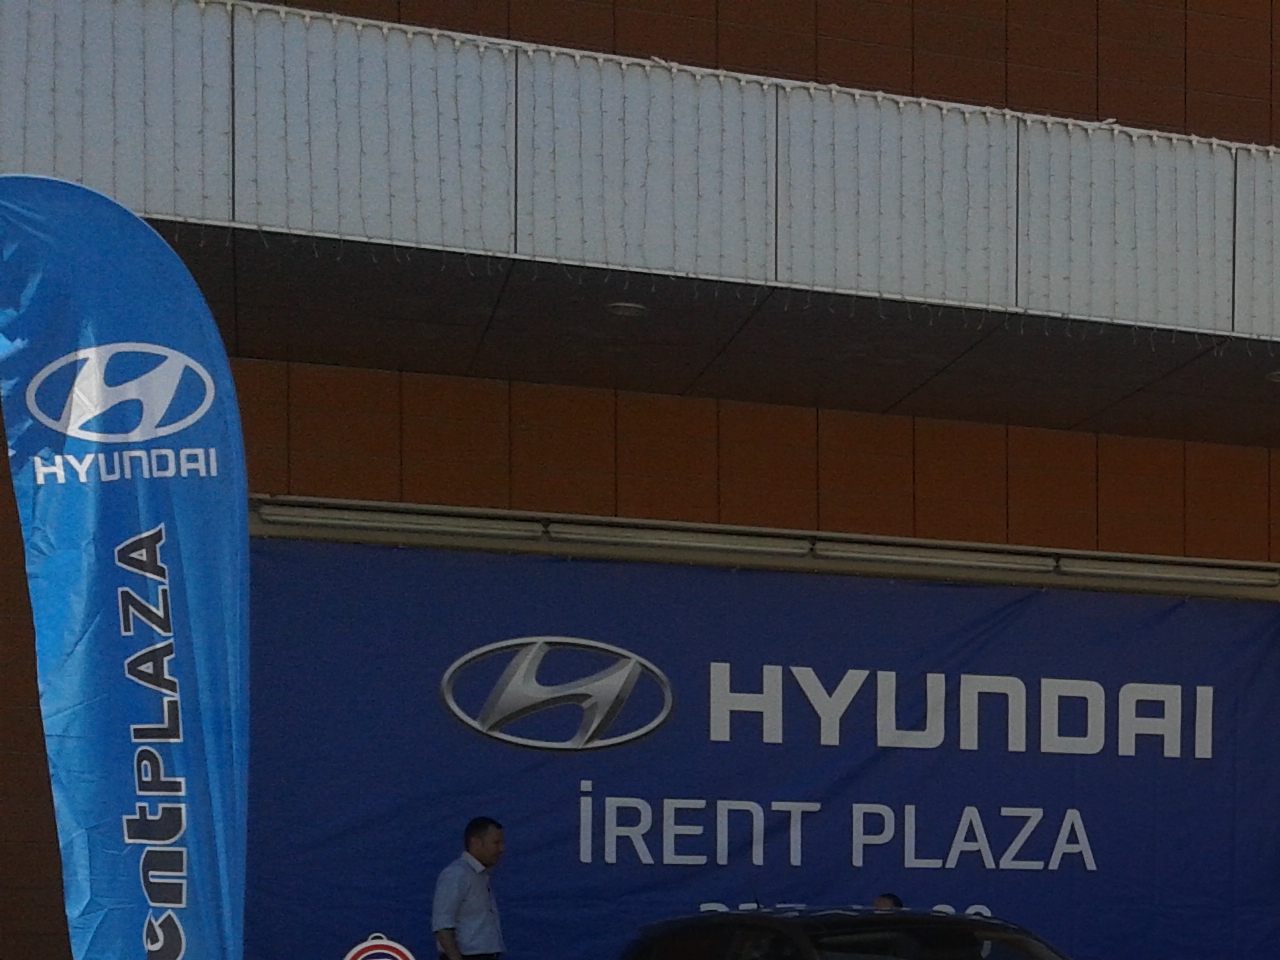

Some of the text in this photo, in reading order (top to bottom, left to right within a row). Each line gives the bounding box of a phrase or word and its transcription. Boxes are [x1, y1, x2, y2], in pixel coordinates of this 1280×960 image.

[34, 448, 218, 485] HYUNDAI
[709, 661, 1215, 759] HYUNDAI
[851, 802, 1098, 871] PLAZA
